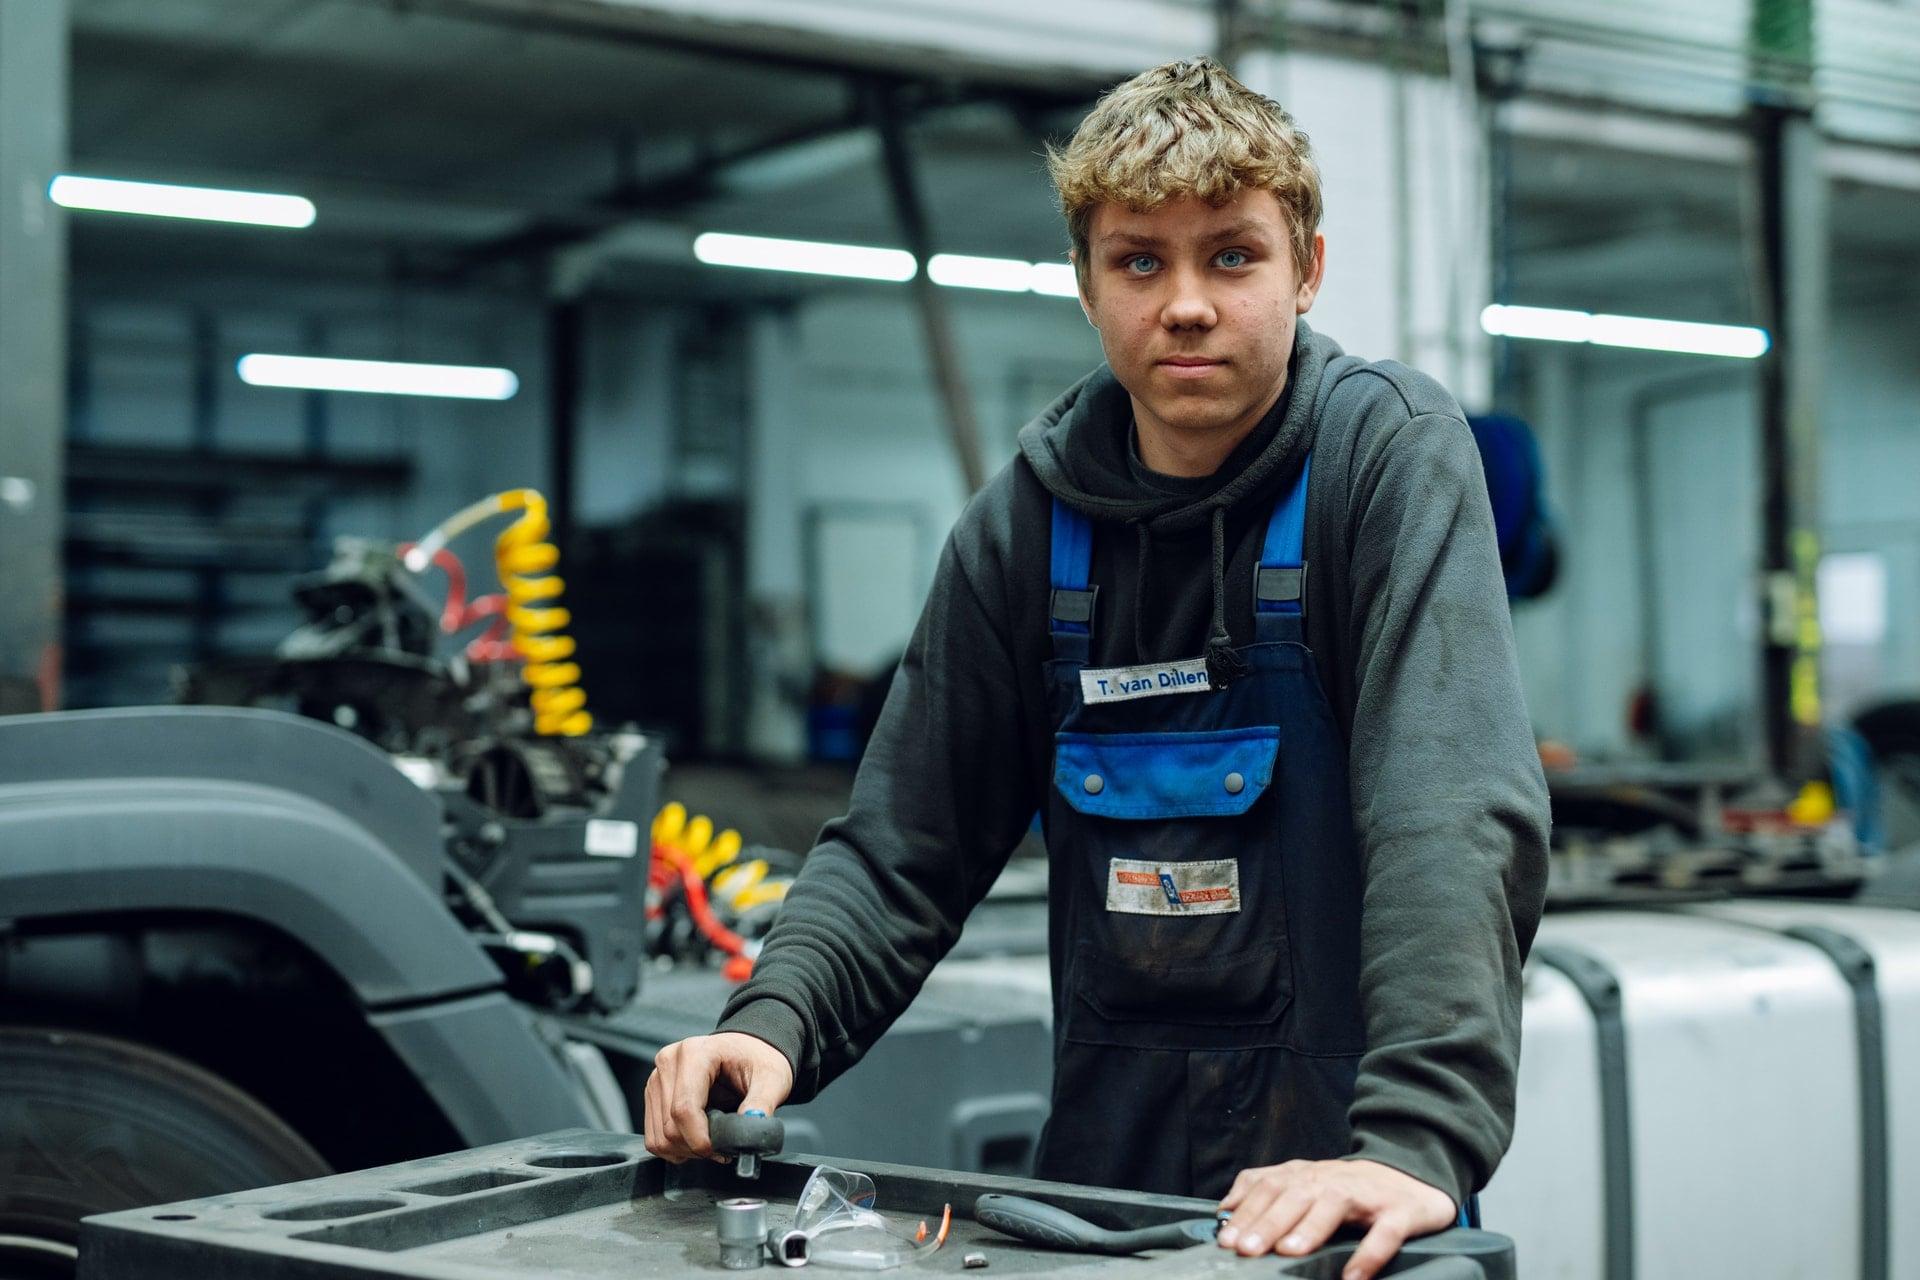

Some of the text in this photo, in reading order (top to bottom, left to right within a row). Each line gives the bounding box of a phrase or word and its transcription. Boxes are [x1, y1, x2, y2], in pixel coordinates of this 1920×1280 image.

[1097, 671, 1207, 695] T. van Dillen
